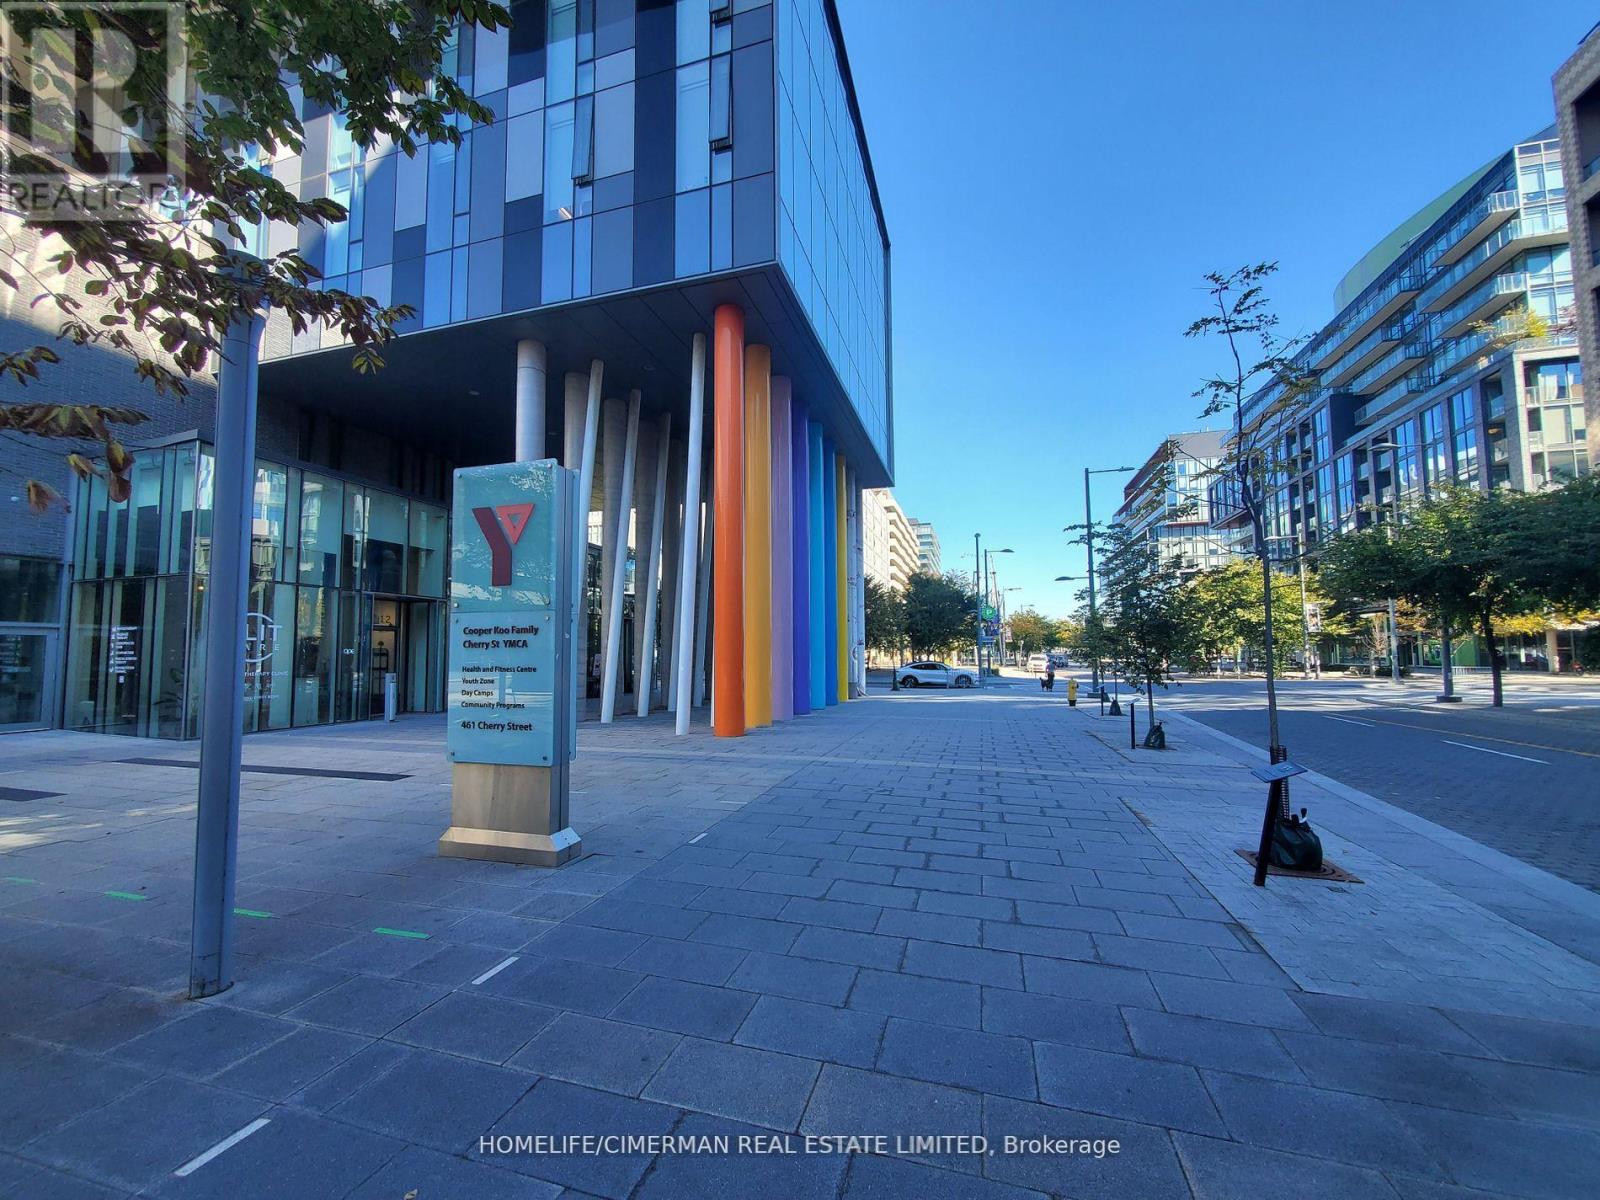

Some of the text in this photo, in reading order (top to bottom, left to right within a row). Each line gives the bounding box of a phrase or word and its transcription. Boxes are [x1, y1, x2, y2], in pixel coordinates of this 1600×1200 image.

[463, 625, 539, 637] Cooper Koo Family
[463, 640, 490, 650] Cherry
[503, 640, 528, 648] YMCA
[462, 665, 537, 673] Health and Fitness Centre
[461, 701, 495, 709] Community
[461, 721, 533, 732] 461 Cherry Street
